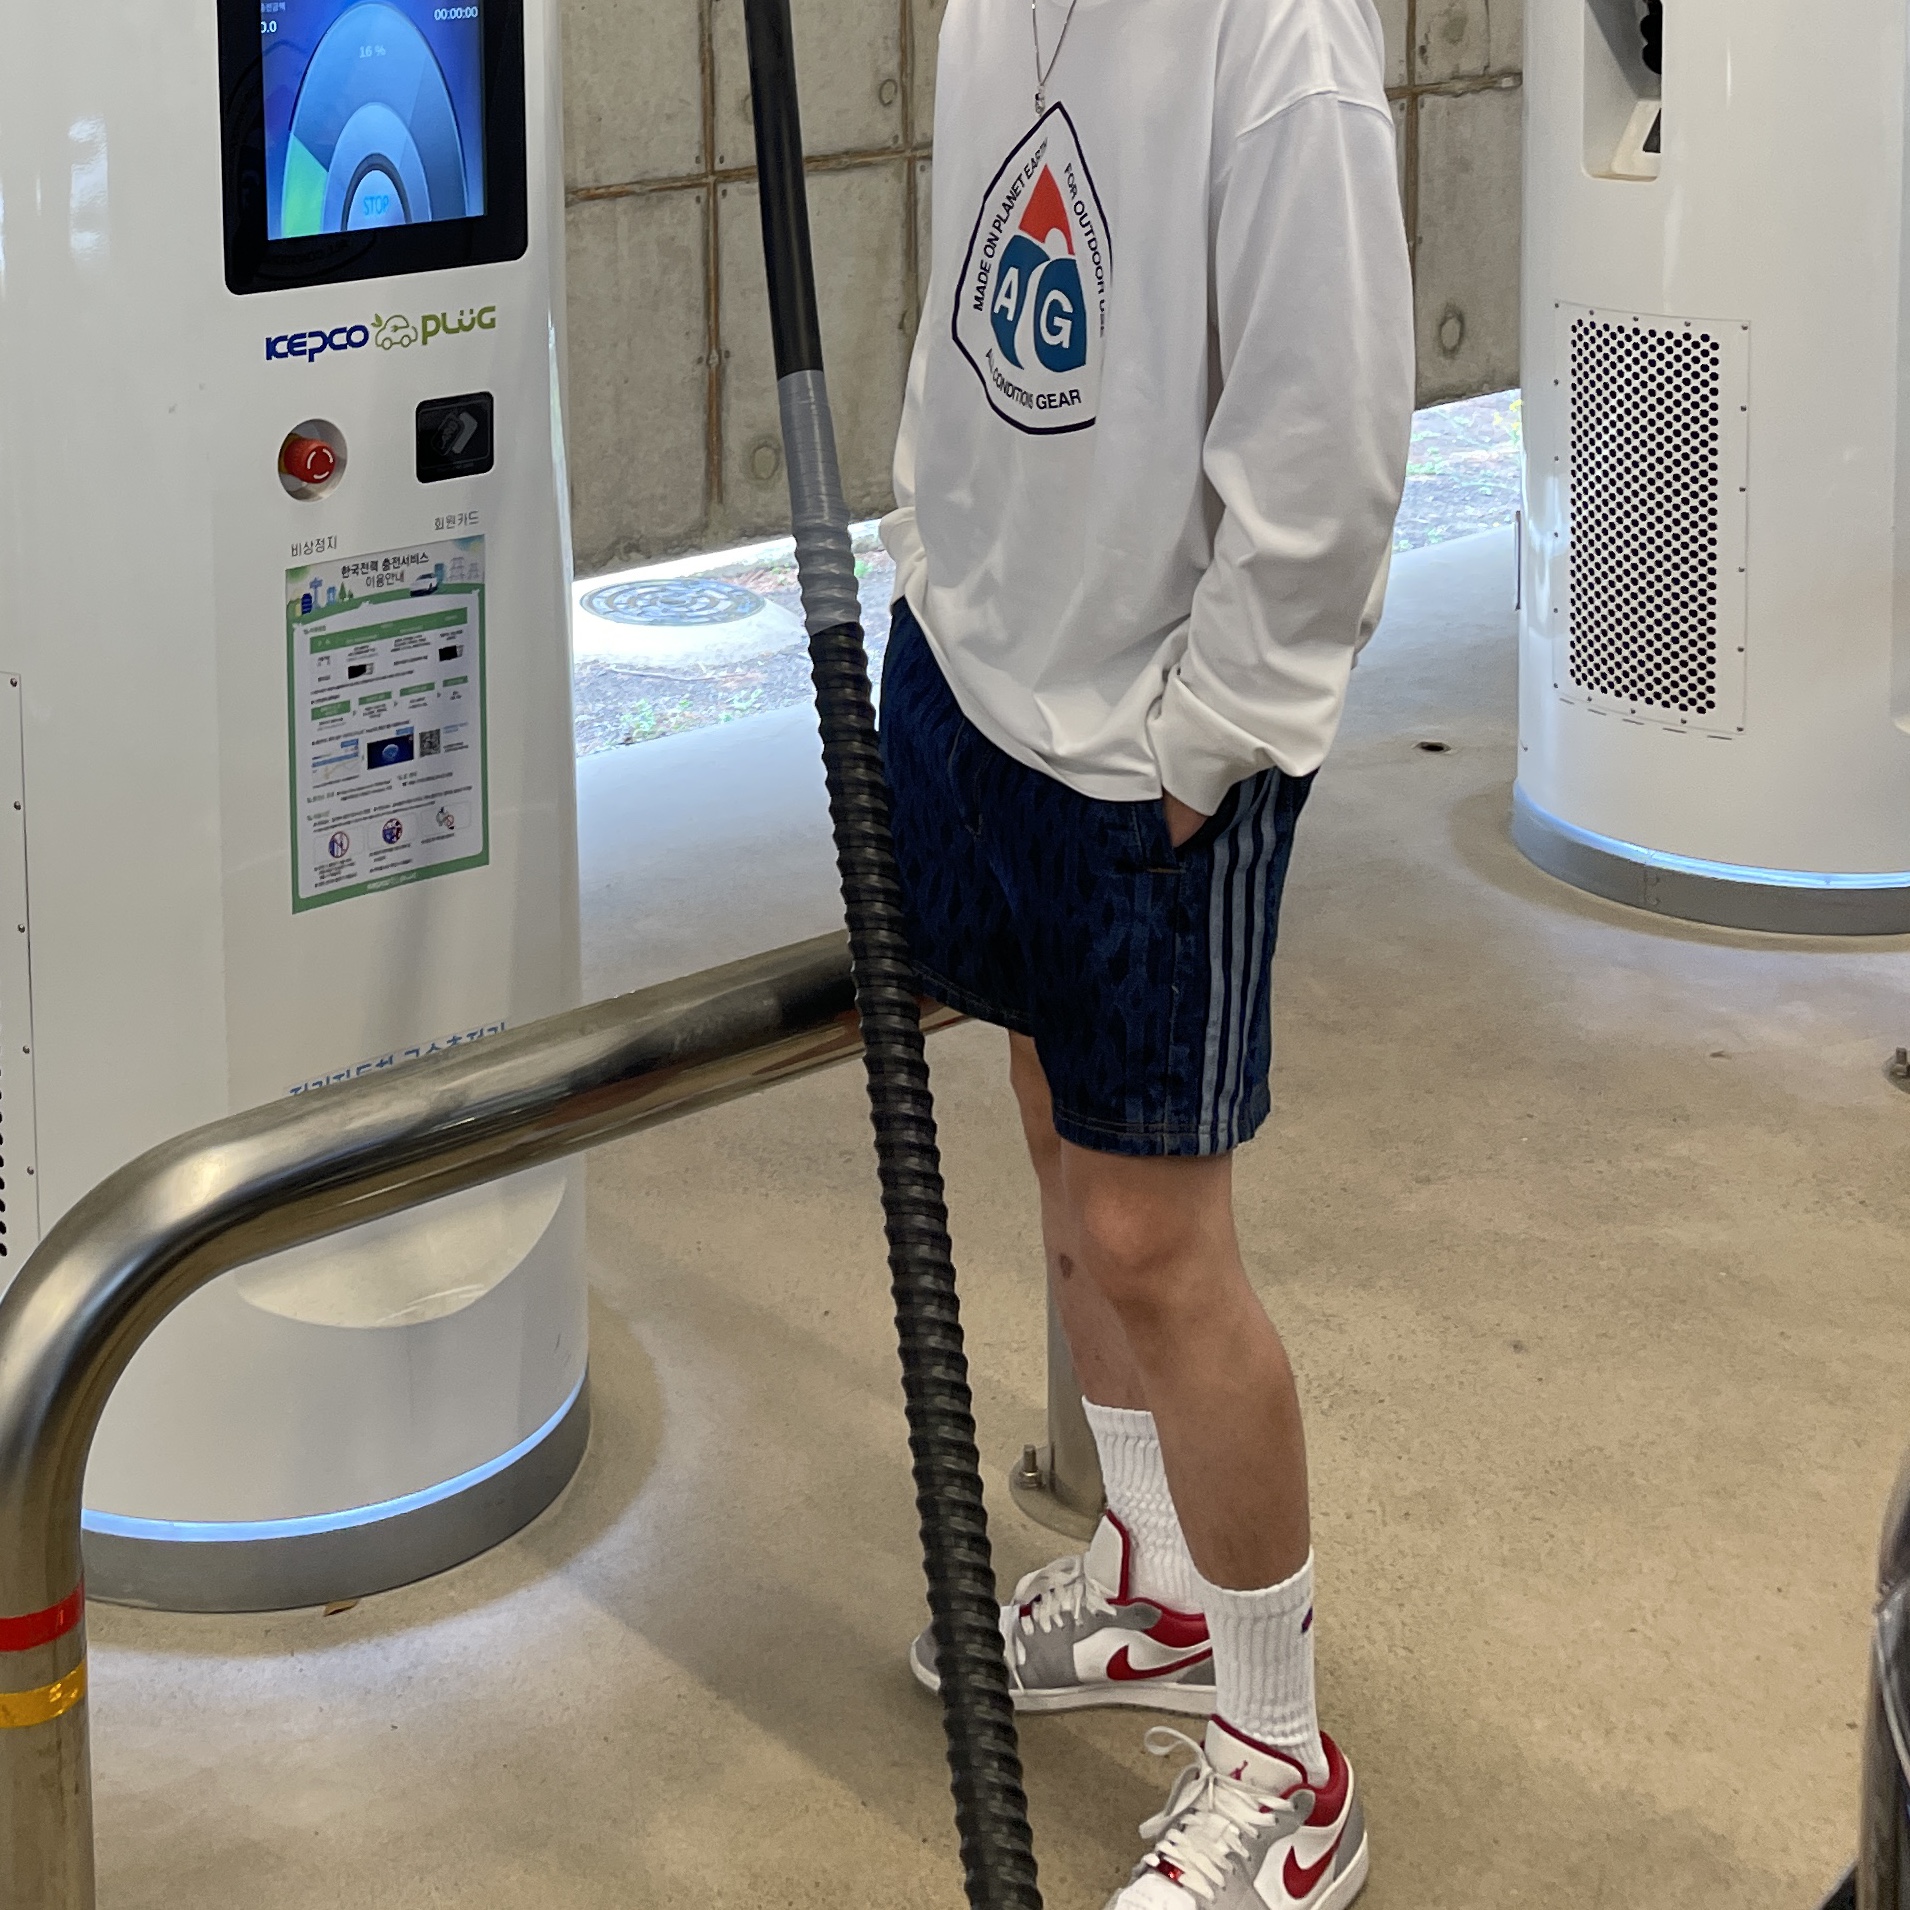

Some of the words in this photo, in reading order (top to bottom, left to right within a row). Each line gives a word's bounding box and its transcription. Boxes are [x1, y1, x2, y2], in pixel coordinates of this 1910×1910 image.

[359, 44, 373, 59] 16
[1064, 162, 1078, 201] FOR
[363, 195, 390, 216] STOP
[973, 259, 991, 312] MADE
[983, 232, 1000, 259] ON
[992, 172, 1025, 234] PLANET
[265, 324, 370, 363] KEPCO
[1036, 389, 1082, 410] GEAR
[433, 509, 480, 532] 회원카드
[290, 533, 338, 559] 비상정지
[365, 570, 405, 588] 이용안내
